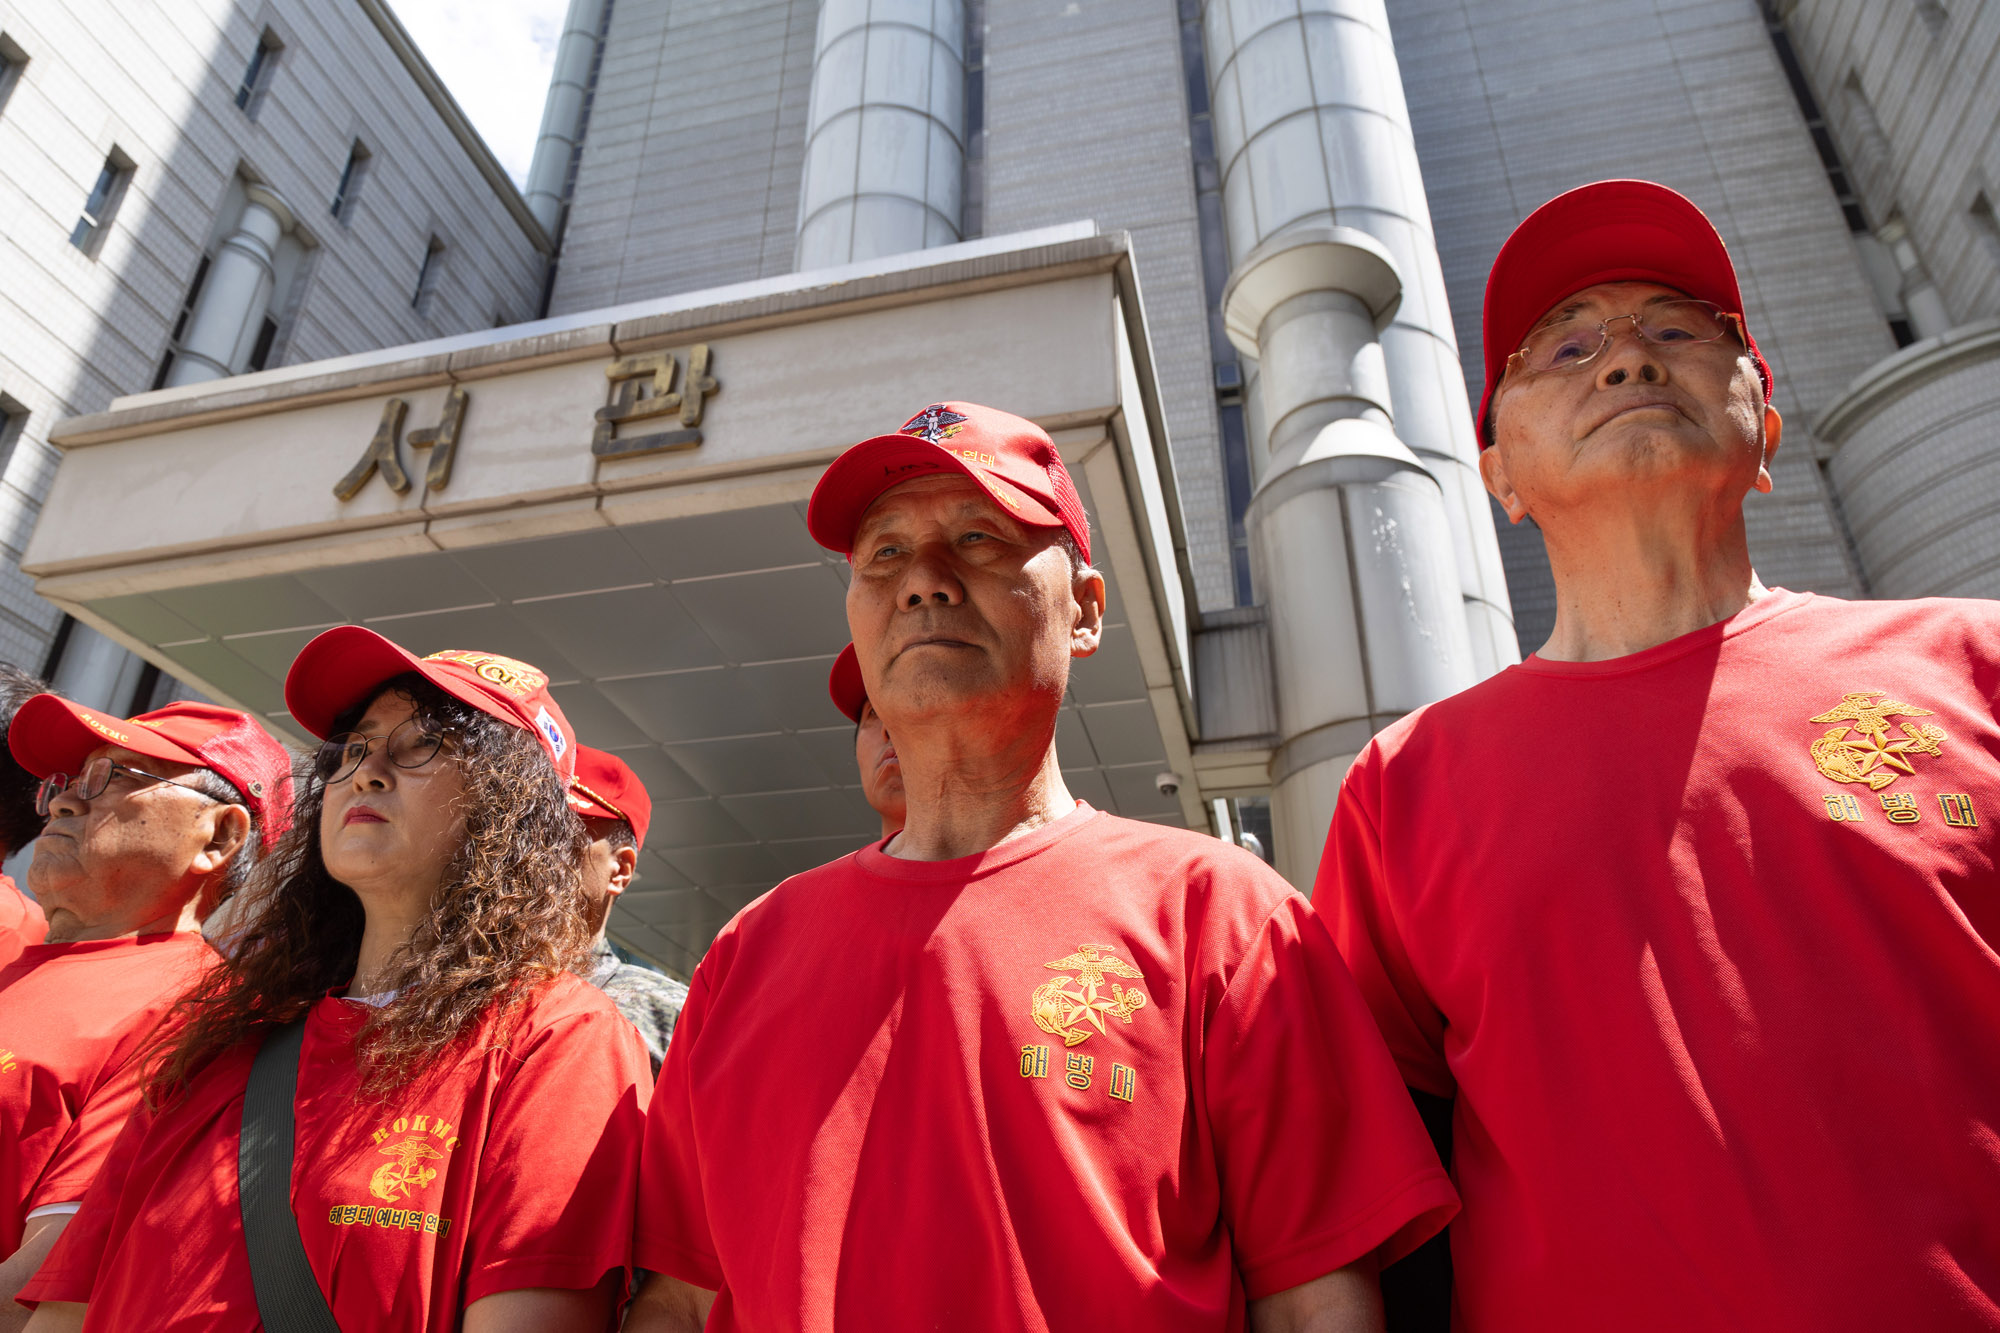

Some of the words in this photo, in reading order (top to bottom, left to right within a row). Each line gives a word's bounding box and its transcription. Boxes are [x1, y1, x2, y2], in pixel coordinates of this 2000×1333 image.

[80, 713, 129, 743] ROKMC
[372, 1115, 462, 1152] ROKMC
[329, 1204, 376, 1226] 해병대
[376, 1207, 425, 1231] 예비역
